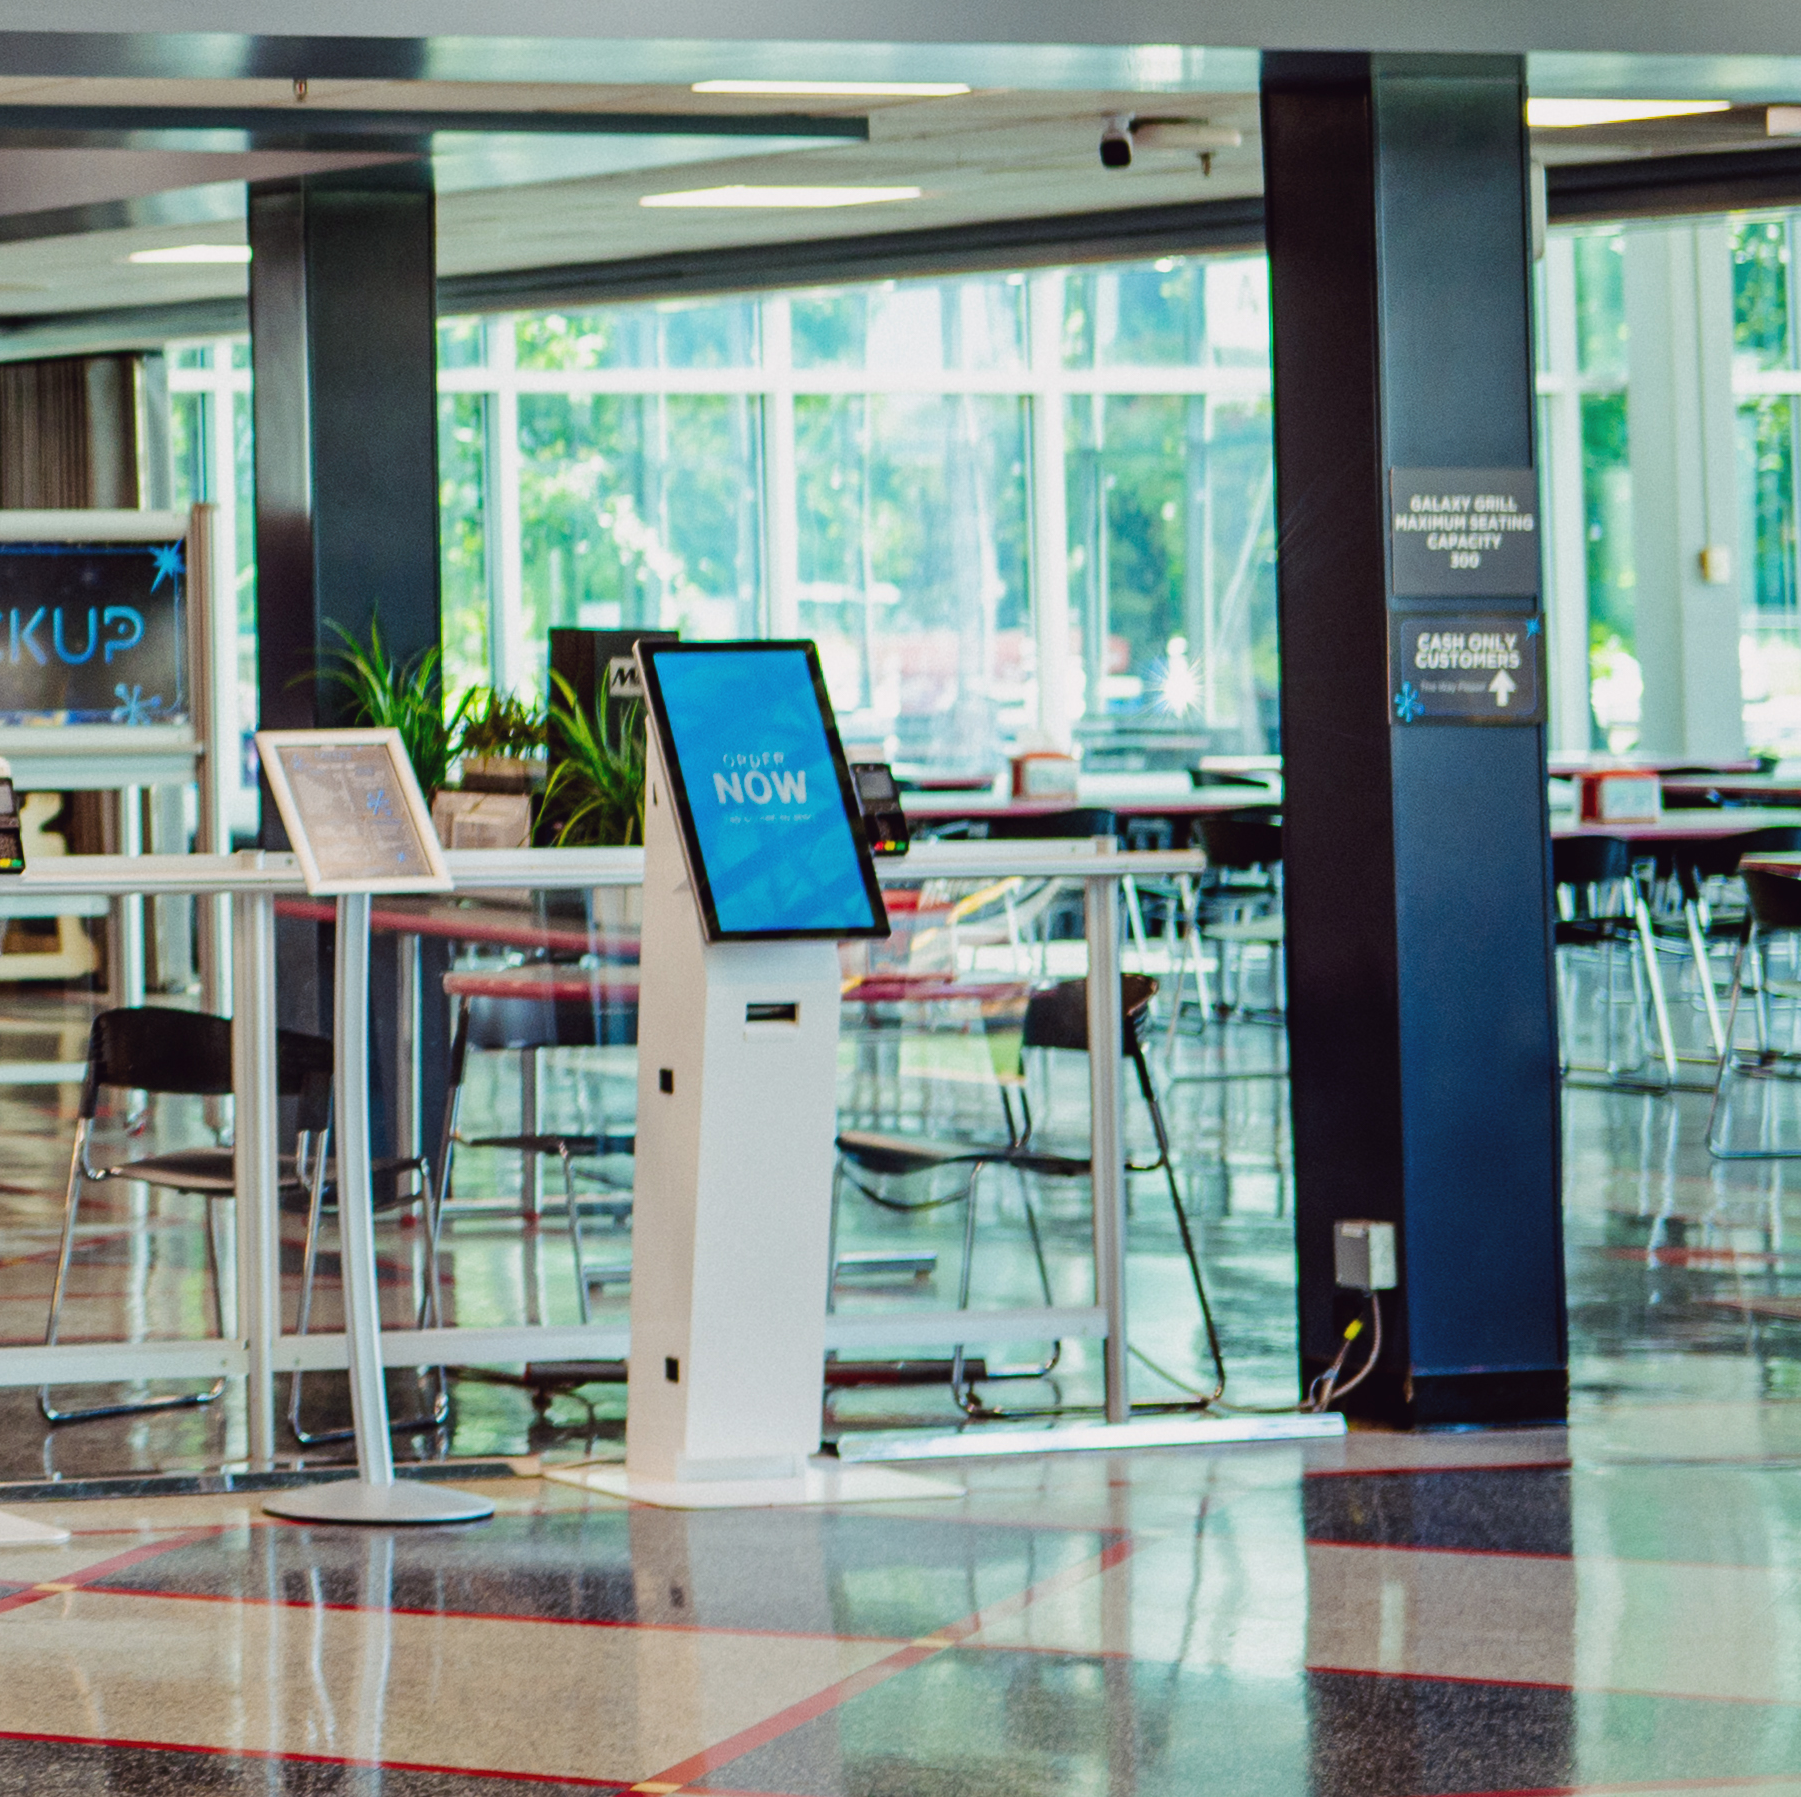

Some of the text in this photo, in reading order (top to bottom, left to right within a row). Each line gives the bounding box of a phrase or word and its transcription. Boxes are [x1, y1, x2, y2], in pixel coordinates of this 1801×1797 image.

[1410, 494, 1518, 513] GALAXY GRILL
[1395, 513, 1534, 532] MAXIMUM SEATING
[1426, 532, 1503, 551] CAPACITY
[1450, 550, 1482, 569] 300
[1417, 632, 1518, 652] CASH ONLY
[1415, 650, 1521, 669] CUSTOMERS
[712, 770, 807, 805] NOW
